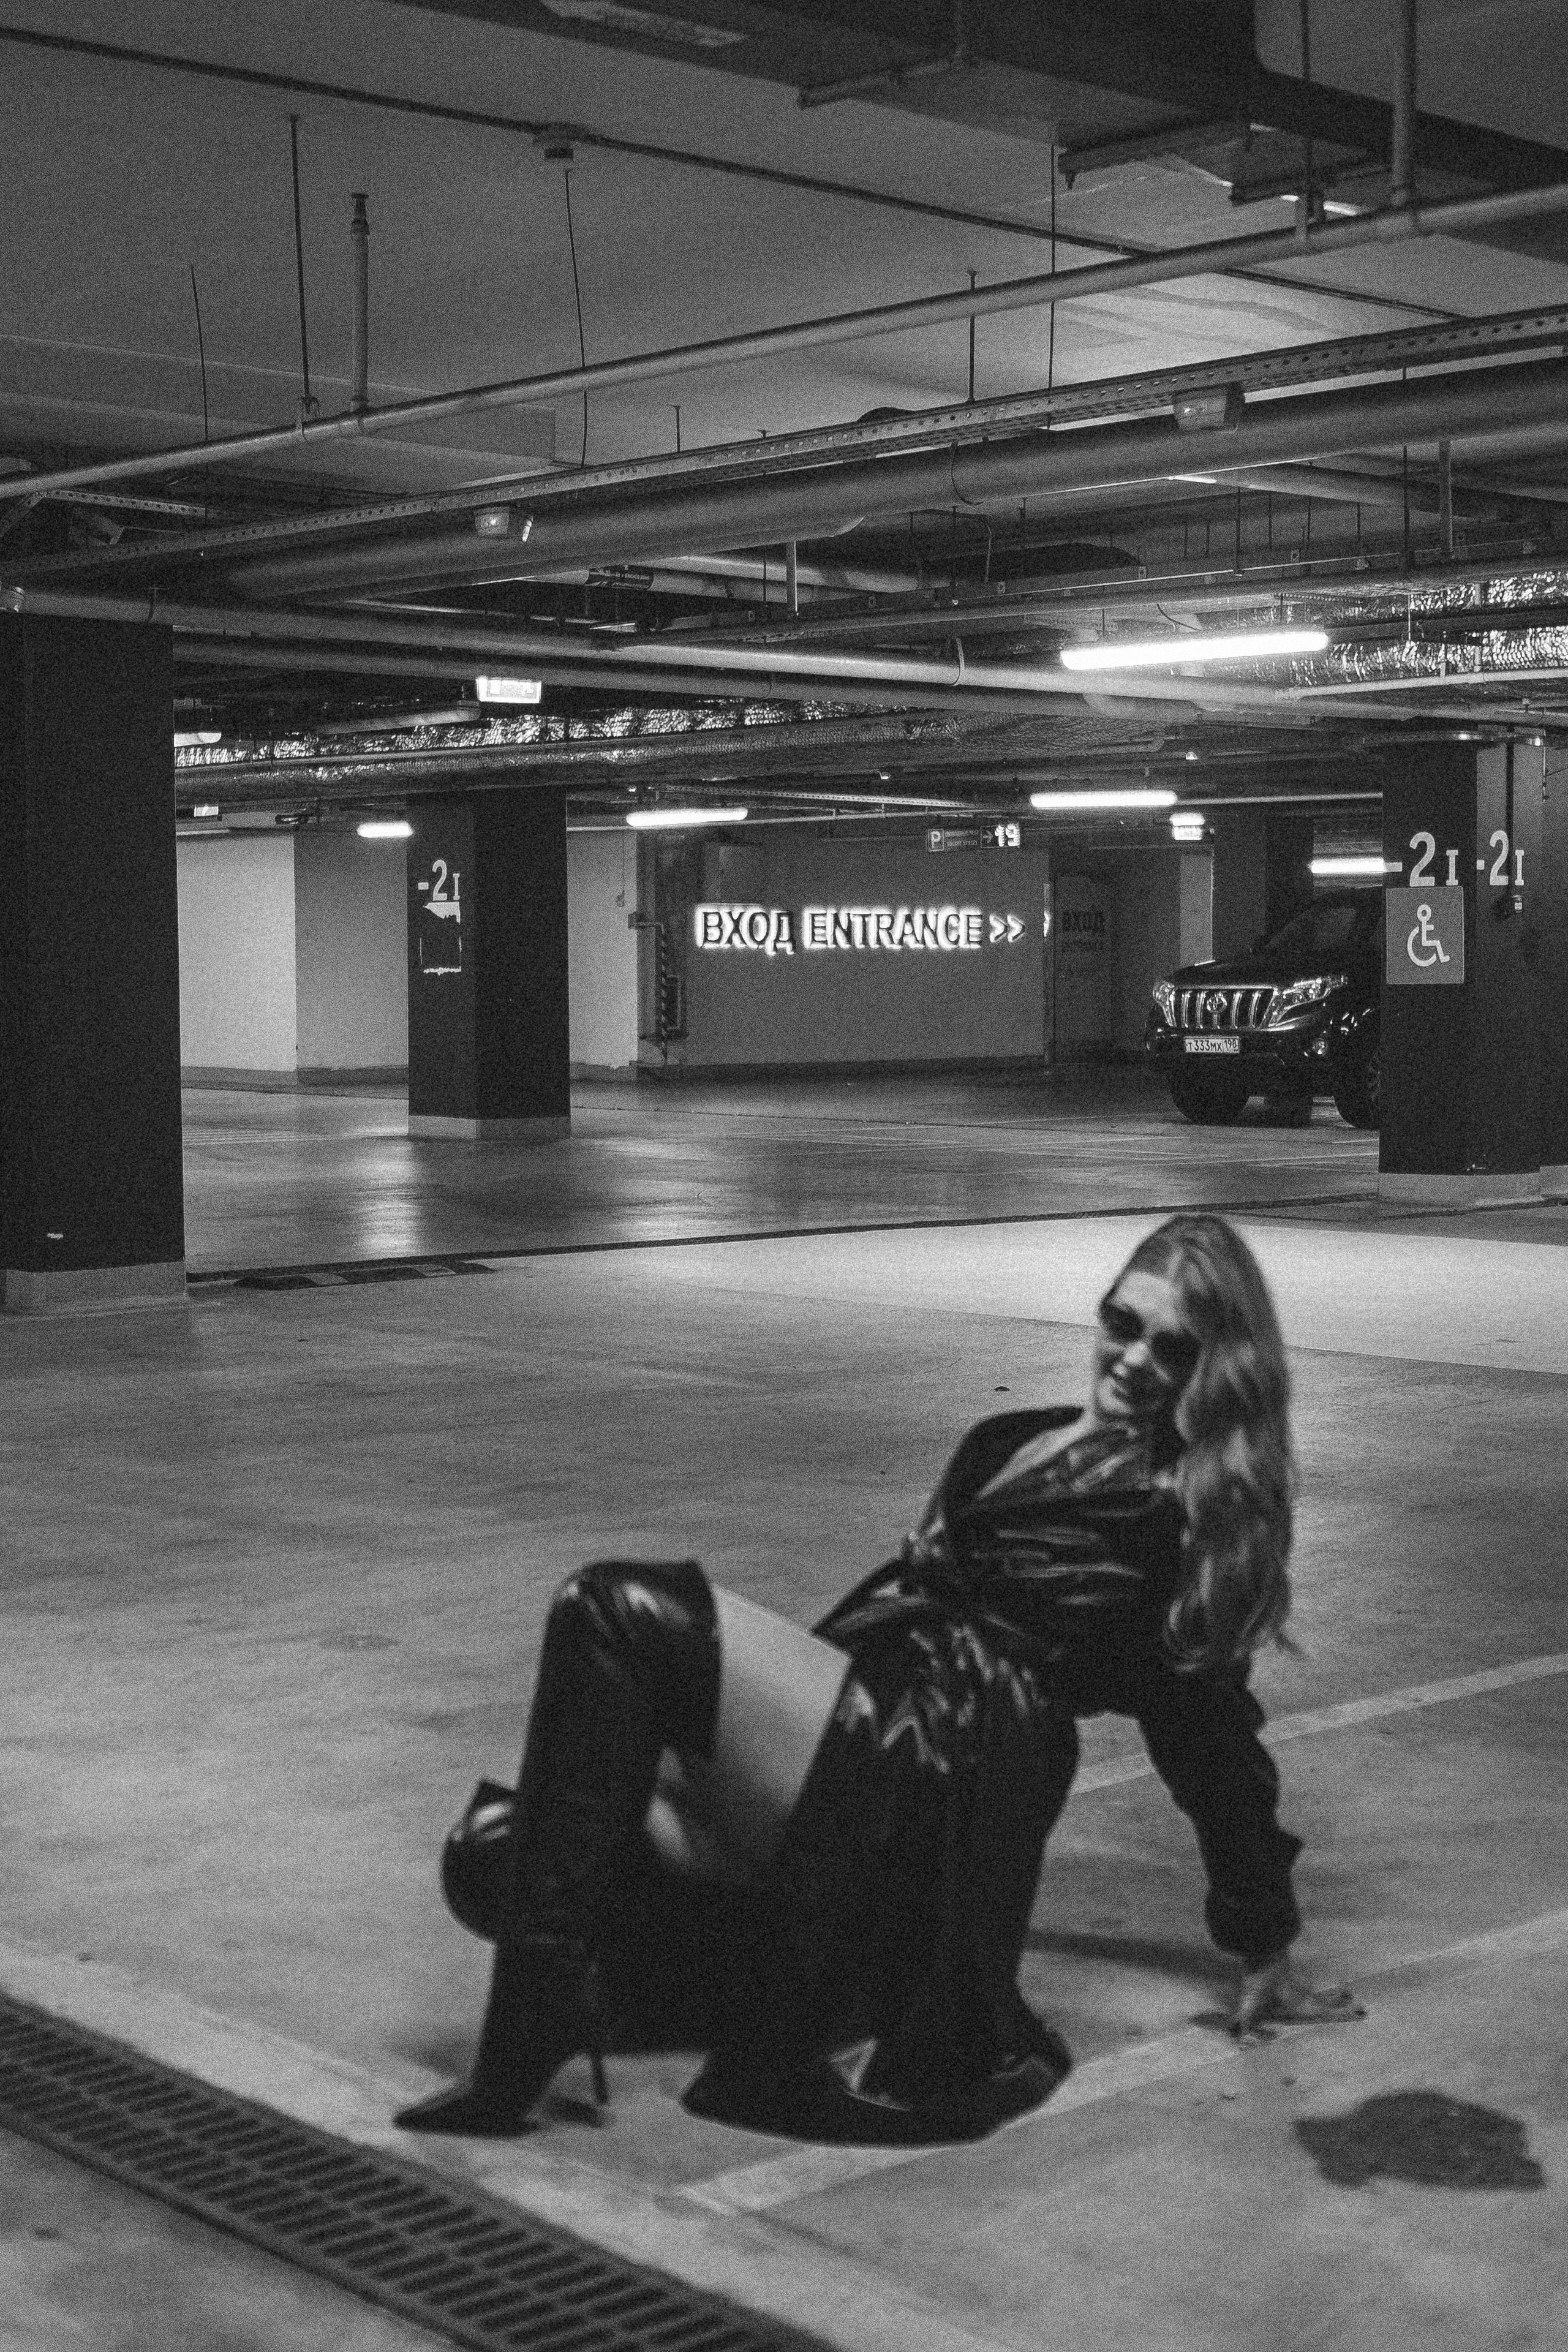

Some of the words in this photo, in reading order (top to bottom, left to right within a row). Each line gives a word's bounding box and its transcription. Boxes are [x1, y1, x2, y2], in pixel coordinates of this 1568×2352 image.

[994, 824, 1020, 847] 19
[698, 909, 796, 956] ВХОД
[804, 908, 982, 949] ENTRANCE
